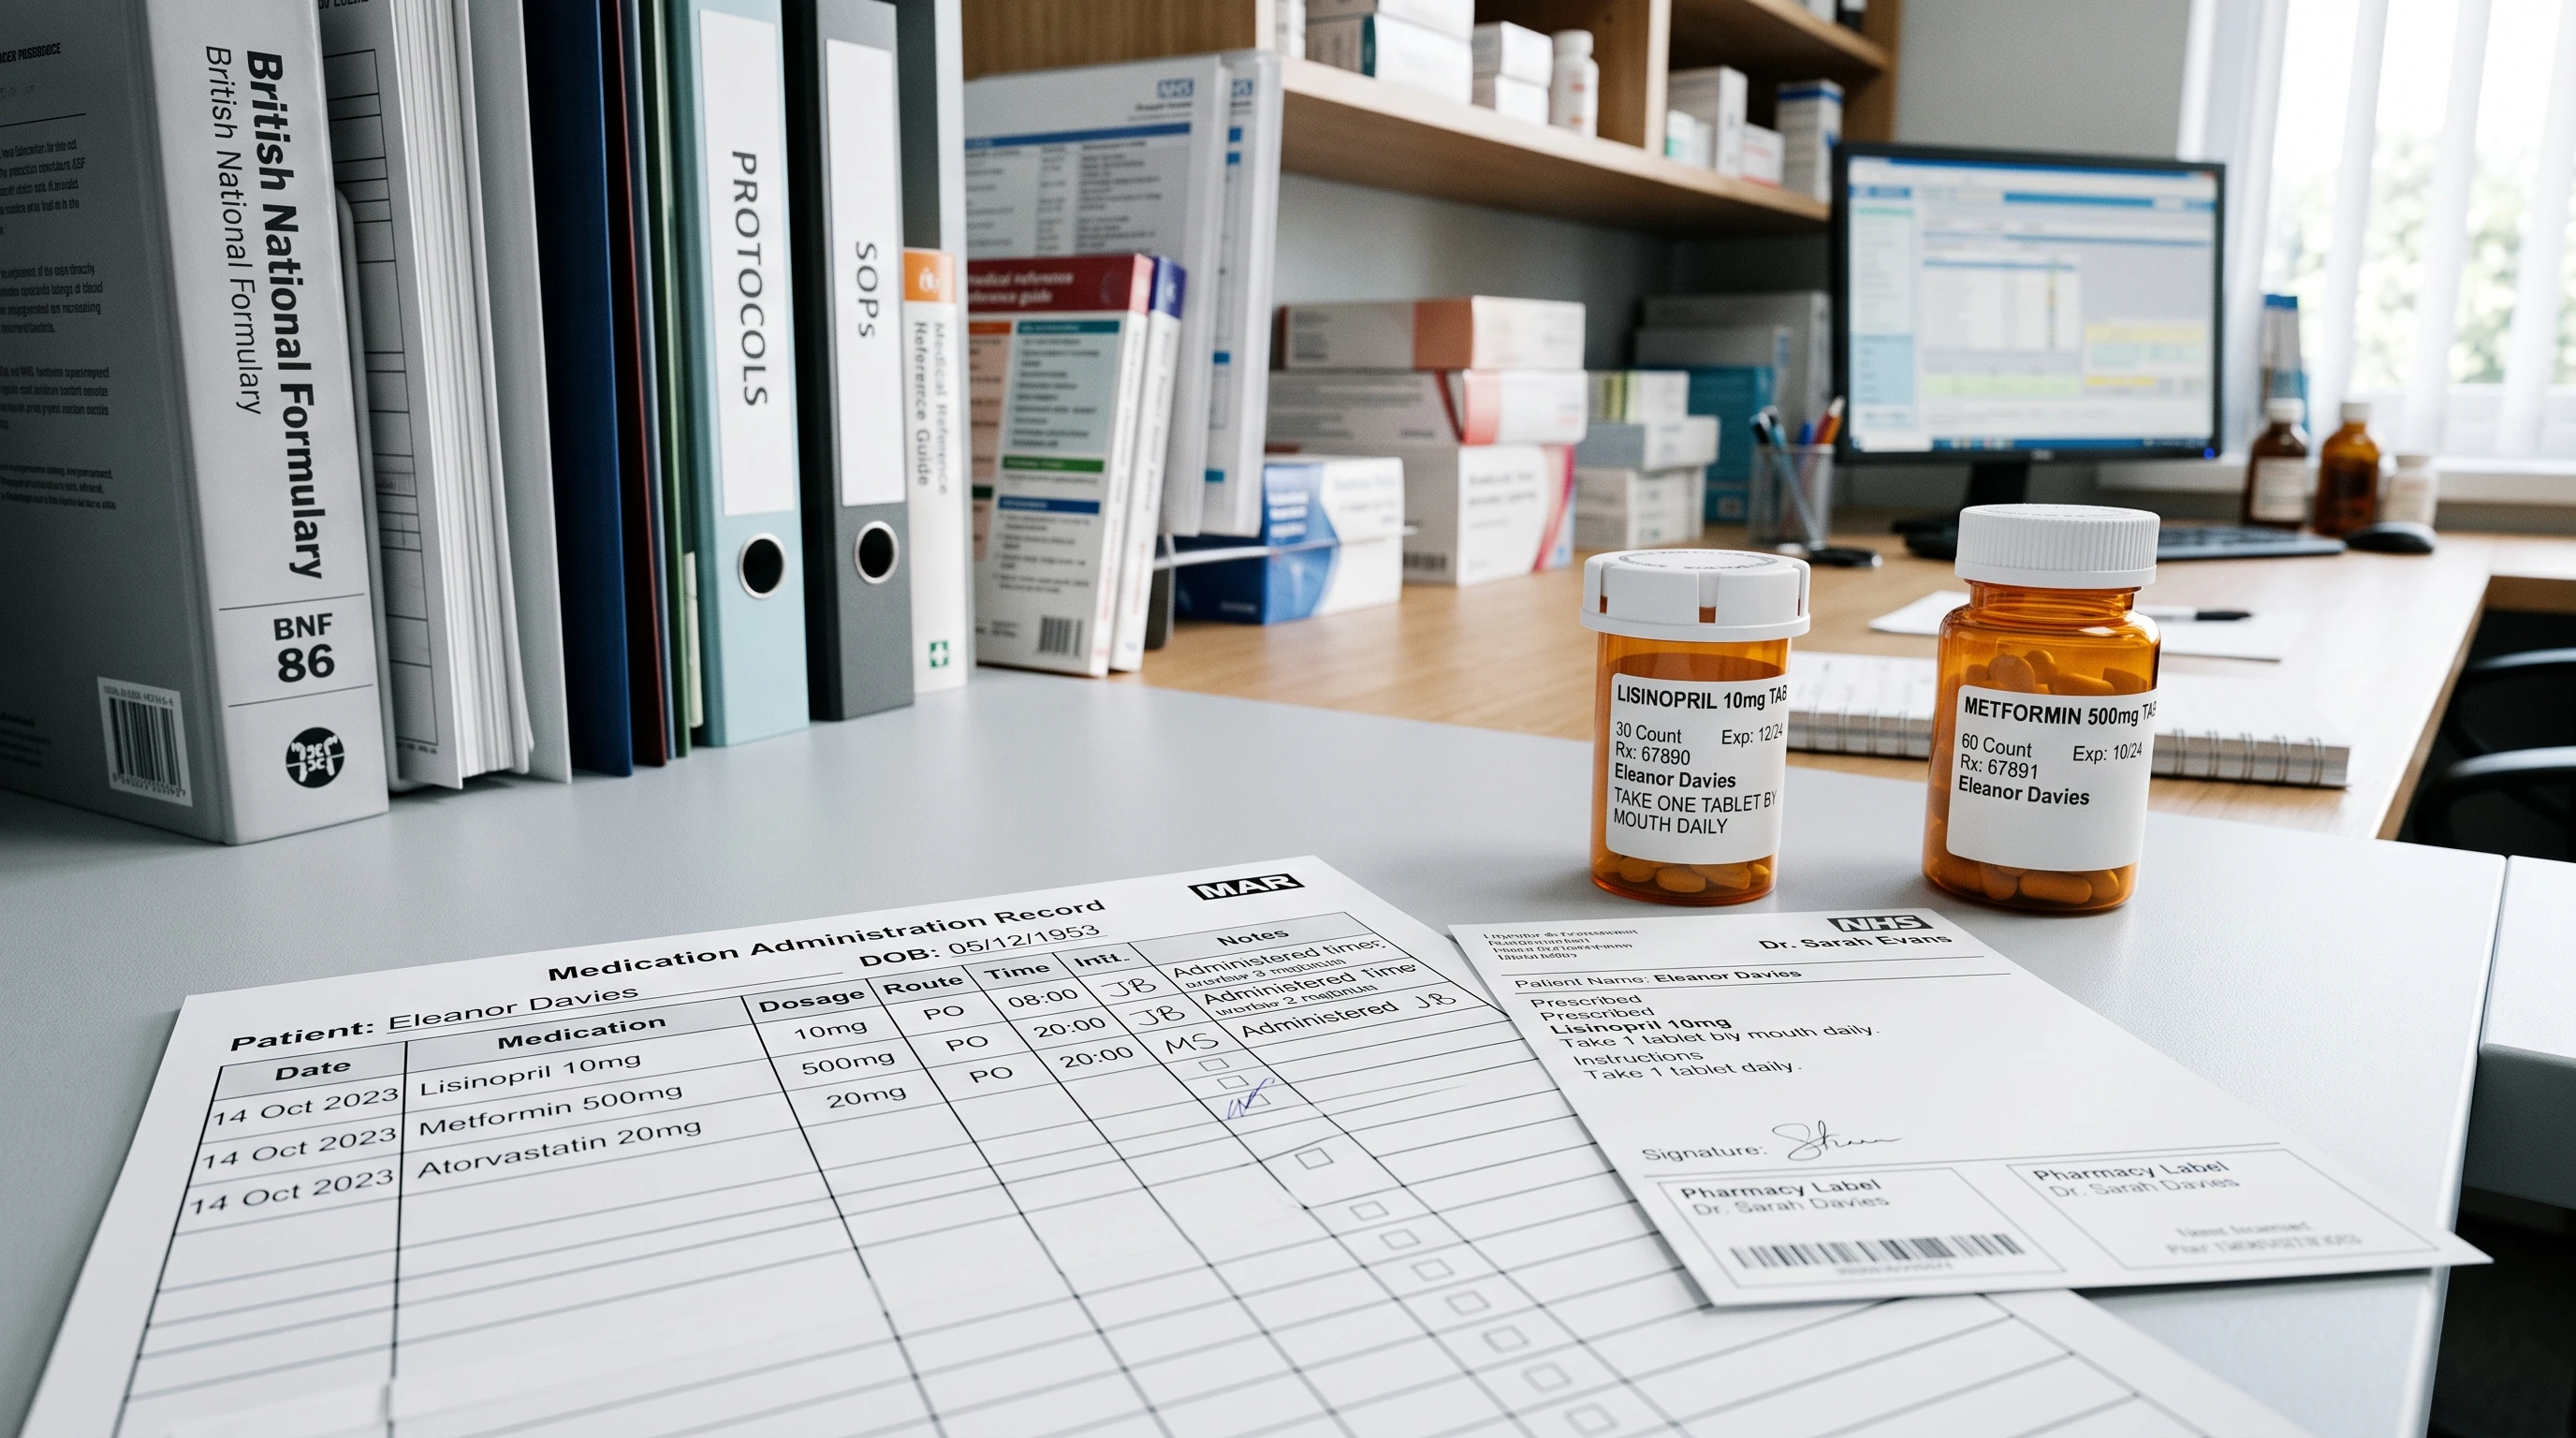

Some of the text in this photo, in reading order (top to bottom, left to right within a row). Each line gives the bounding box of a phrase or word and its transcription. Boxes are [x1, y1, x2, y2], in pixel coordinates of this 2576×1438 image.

[206, 46, 262, 415] British National Formulary
[732, 152, 768, 405] PROTOCOLS
[247, 51, 327, 580] British National Formulary
[916, 429, 931, 487] Guide
[273, 612, 333, 640] BNF
[278, 644, 335, 682] 86
[1618, 684, 1717, 709] LISINOPRIL
[1724, 692, 1765, 711] 10mg
[1965, 697, 2081, 725] METFORMIN
[2088, 708, 2138, 726] 500mg
[1617, 722, 1782, 747] 30 Count Exp: 12/24
[1617, 741, 1690, 765] Rx: 67890
[1962, 733, 2142, 764] 60 Count Exp: 10/24
[1616, 762, 1735, 788] Eleanor Davies
[1961, 754, 2037, 779] Rx: 67891
[1615, 786, 1778, 814] TAKE ONE TABLET BY
[1959, 775, 2089, 805] Eleanor Davies
[1614, 809, 1727, 834] MOUTH DAILY
[1201, 876, 1296, 899] MAR
[1837, 917, 1923, 931] NHS
[549, 900, 1105, 981] Medication Administration Record
[1801, 938, 1873, 947] Sarah
[1876, 936, 1952, 945] Evans
[1173, 947, 1320, 978] Administered
[231, 924, 1101, 1051] Patient: Eleanor Davies DOB: 05/12/1953
[1101, 978, 1156, 997] JB
[1204, 972, 1356, 1005] Administered
[1654, 974, 1728, 982] Eleanor
[276, 1063, 351, 1080] Date
[499, 1017, 666, 1049] Medication
[759, 991, 865, 1012] Dosage
[883, 974, 963, 994] Route
[984, 965, 1049, 979] Time
[1216, 928, 1289, 948] Notes
[1530, 995, 1642, 1007] Prescribed
[1129, 1005, 1185, 1026] JB
[1243, 1002, 1399, 1037] Administered
[1541, 1007, 1654, 1022] Prescribed
[1550, 1020, 1732, 1034] Lisinopril 10mg
[1165, 1033, 1220, 1054] MS
[1559, 1038, 1616, 1048] Take
[1623, 1036, 1634, 1045] 1
[1643, 1034, 1705, 1044] tablet
[1823, 1025, 1879, 1035] daily.
[214, 990, 1077, 1125] 14 Oct 2023 Lisinopril 10mg 10mg PO 08:00
[1573, 1052, 1703, 1065] Instructions
[1584, 1062, 1801, 1078] Take 1 tablet daily.
[204, 1016, 1106, 1168] 14 Oct 2023 Metformin 500mg 500mg PO 20:00
[190, 1047, 1133, 1217] 14 Oct 2023 Atorvastatin 20mg 20mg PO 20:00
[1643, 1147, 1766, 1162] Signature:
[2033, 1161, 2229, 1181] Pharmacy Label
[1681, 1180, 1881, 1198] Pharmacy Label
[2048, 1180, 2240, 1199] Dr. Sarah Davies
[1695, 1197, 1890, 1216] Dr. Sarah Davies
